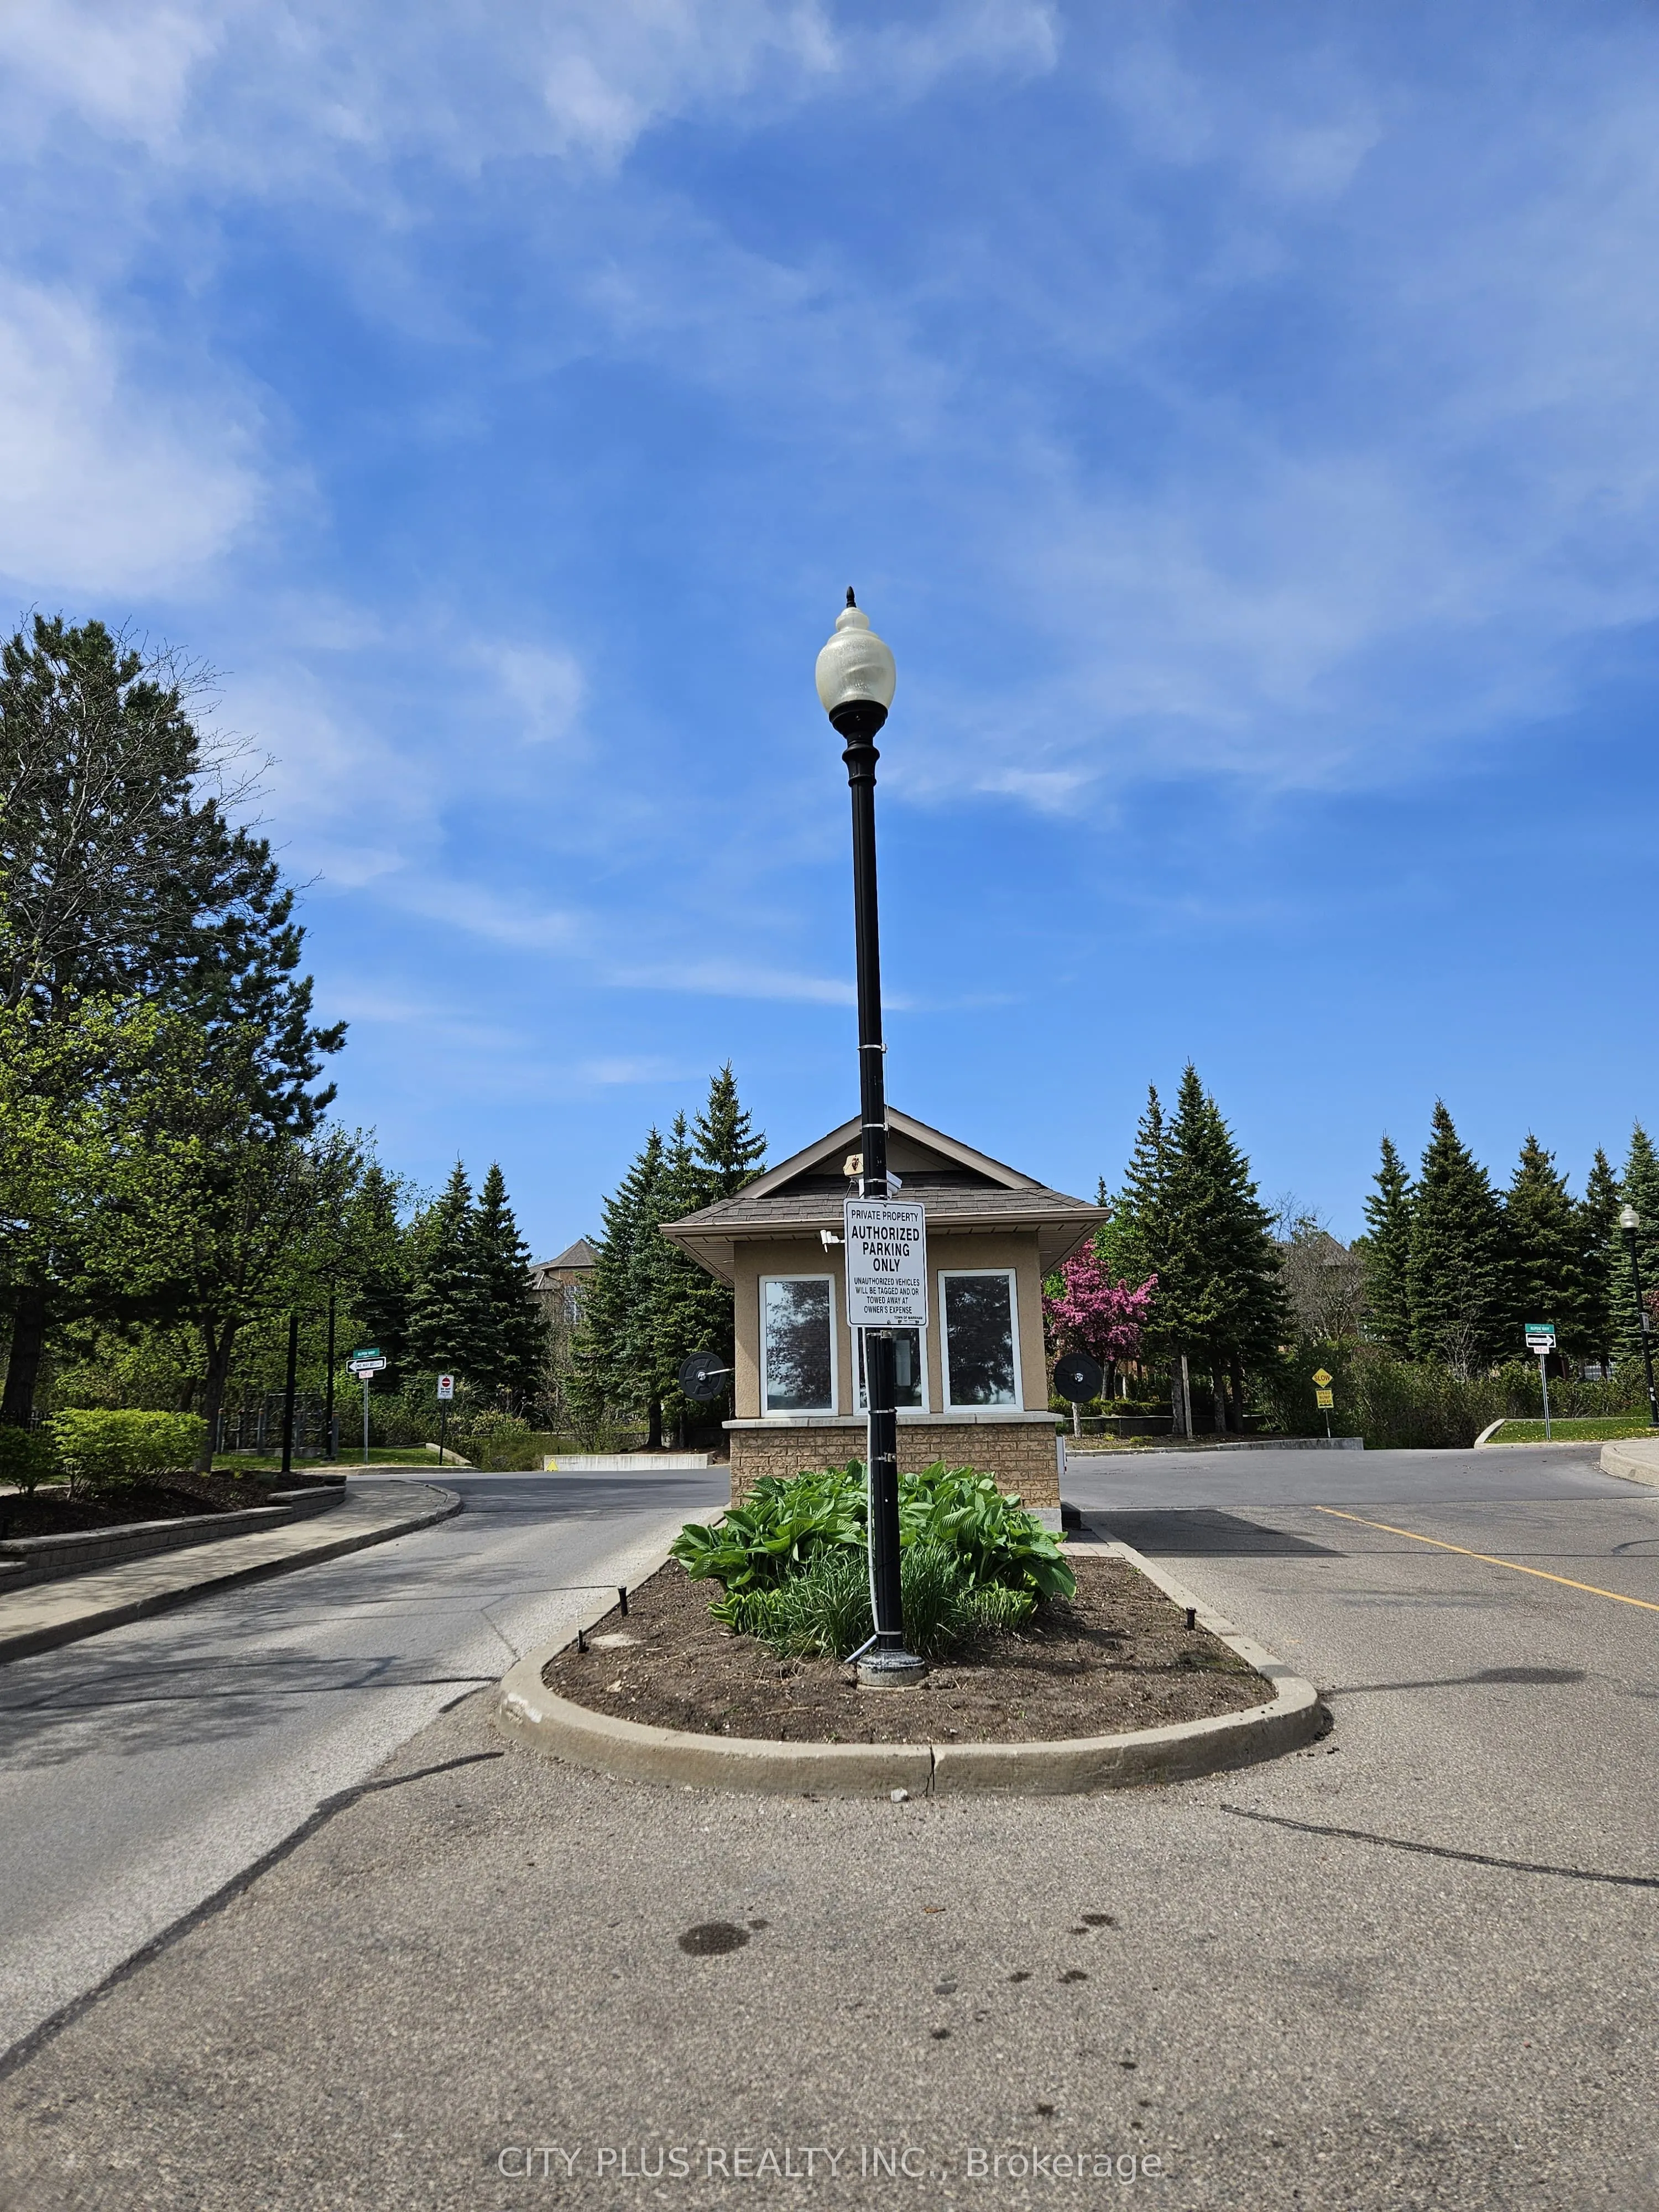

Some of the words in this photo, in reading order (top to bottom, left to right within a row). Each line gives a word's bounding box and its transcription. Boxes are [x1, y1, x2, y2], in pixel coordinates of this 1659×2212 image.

[851, 1209, 881, 1220] PRIVATE
[883, 1211, 918, 1222] PROPERTY
[852, 1225, 920, 1241] AUTHORIZED
[863, 1241, 910, 1256] PARKING
[873, 1258, 900, 1272] ONLY
[854, 1277, 894, 1285] UNAUTHORIZED
[895, 1278, 920, 1286] VEHICLES
